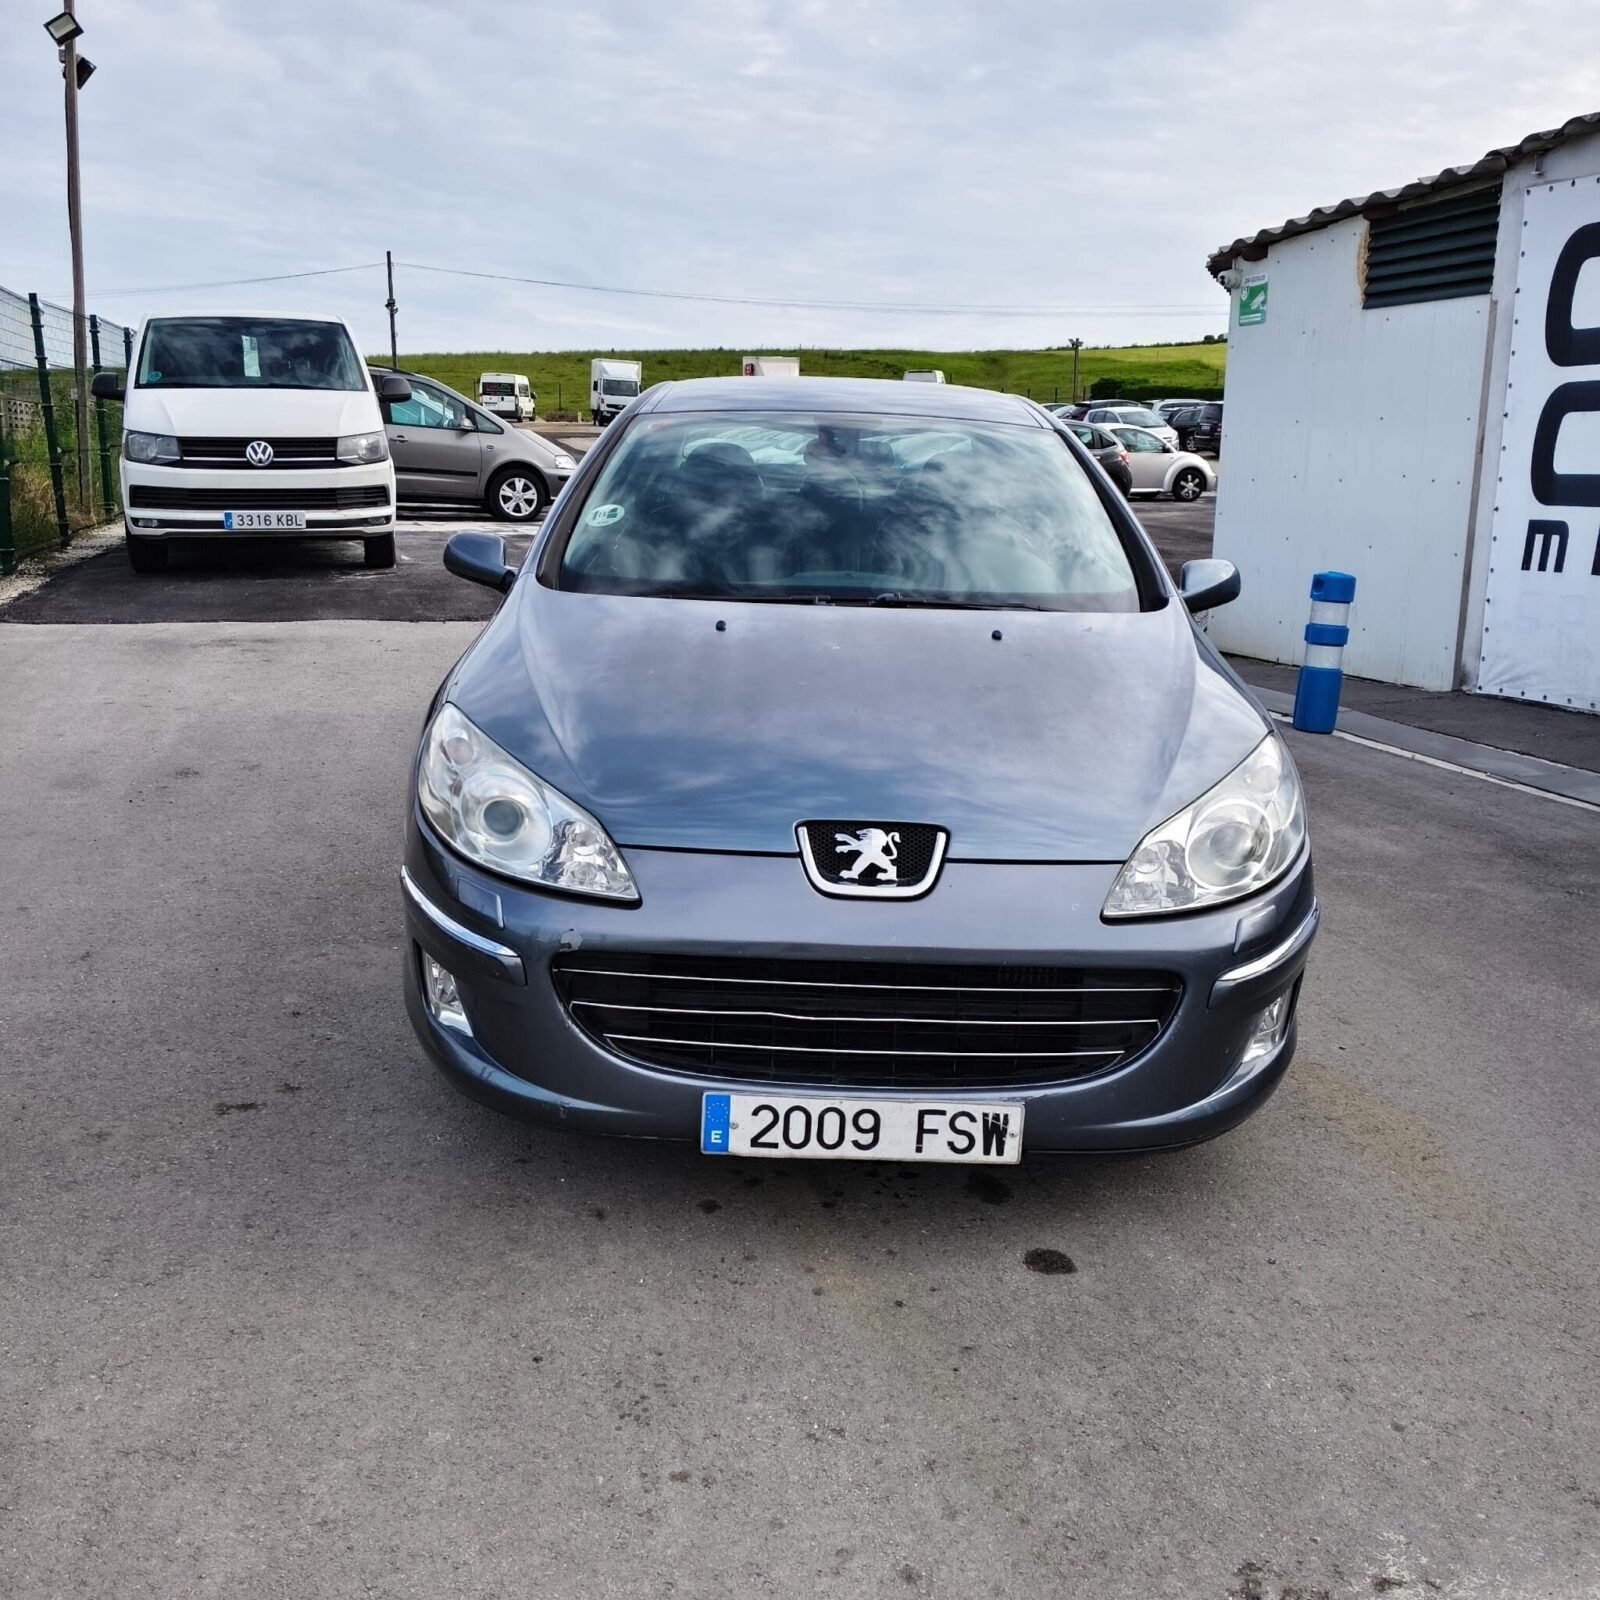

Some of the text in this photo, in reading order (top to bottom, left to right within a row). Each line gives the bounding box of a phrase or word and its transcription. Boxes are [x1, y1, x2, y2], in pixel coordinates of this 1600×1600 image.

[237, 514, 303, 527] 3316 KBL
[711, 1104, 1009, 1157] E 2009 FSW
